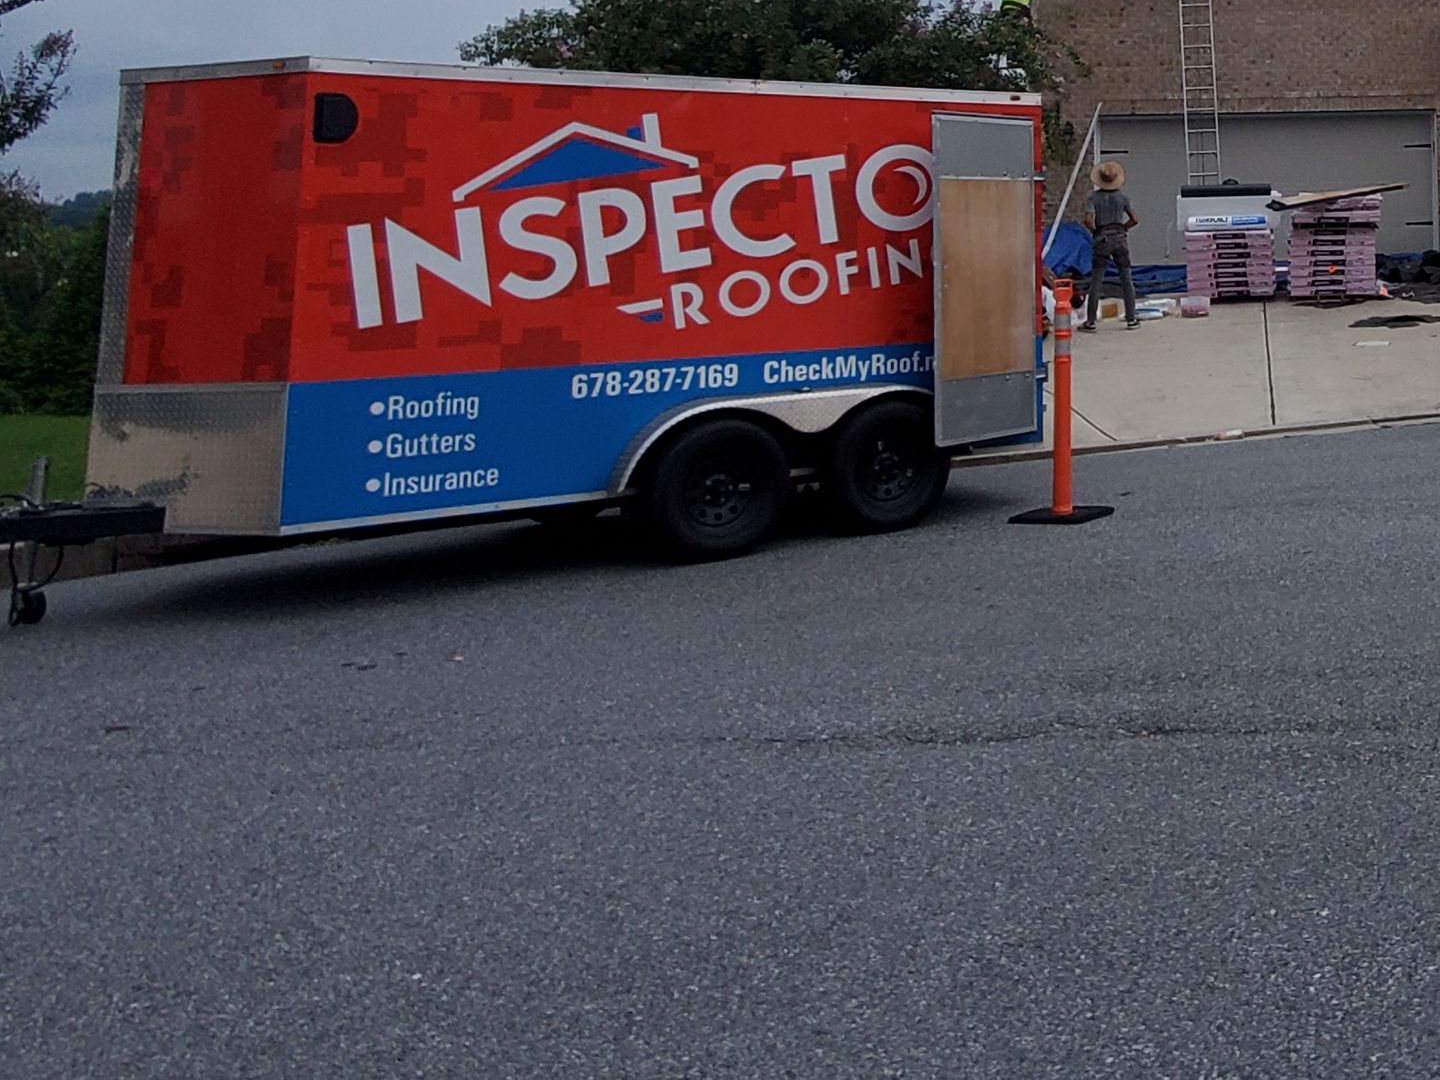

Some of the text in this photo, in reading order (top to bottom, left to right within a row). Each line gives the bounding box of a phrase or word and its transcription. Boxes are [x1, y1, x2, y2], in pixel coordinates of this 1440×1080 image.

[572, 363, 739, 399] 678-287-7169
[388, 391, 479, 420] Roofing
[386, 433, 476, 458] Gutters
[383, 468, 499, 497] Insurance
